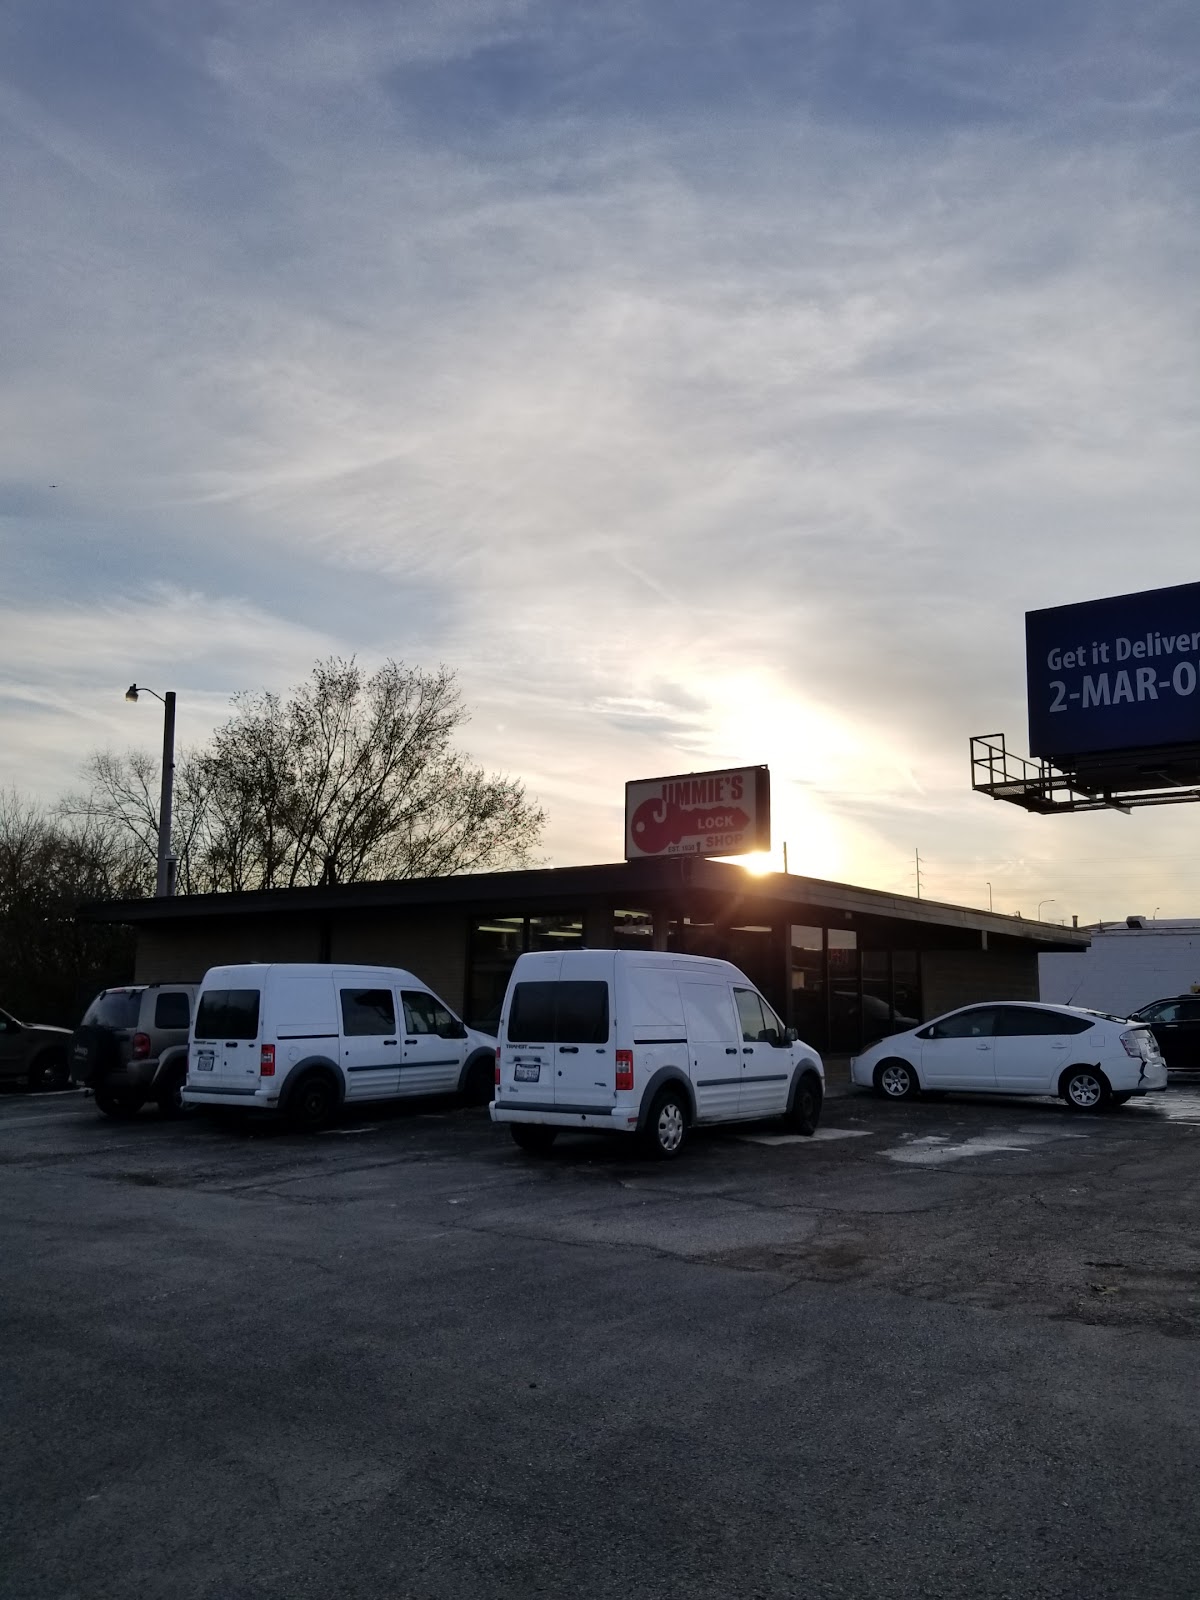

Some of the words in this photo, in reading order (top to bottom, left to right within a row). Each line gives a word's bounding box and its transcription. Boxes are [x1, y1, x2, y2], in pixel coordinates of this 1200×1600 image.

[1047, 645, 1086, 671] Get
[1092, 641, 1109, 664] it
[1049, 660, 1200, 713] 2-MAR-O
[653, 775, 743, 823] JIMMIE'S
[698, 815, 735, 829] LOCK
[706, 834, 743, 847] SHOP
